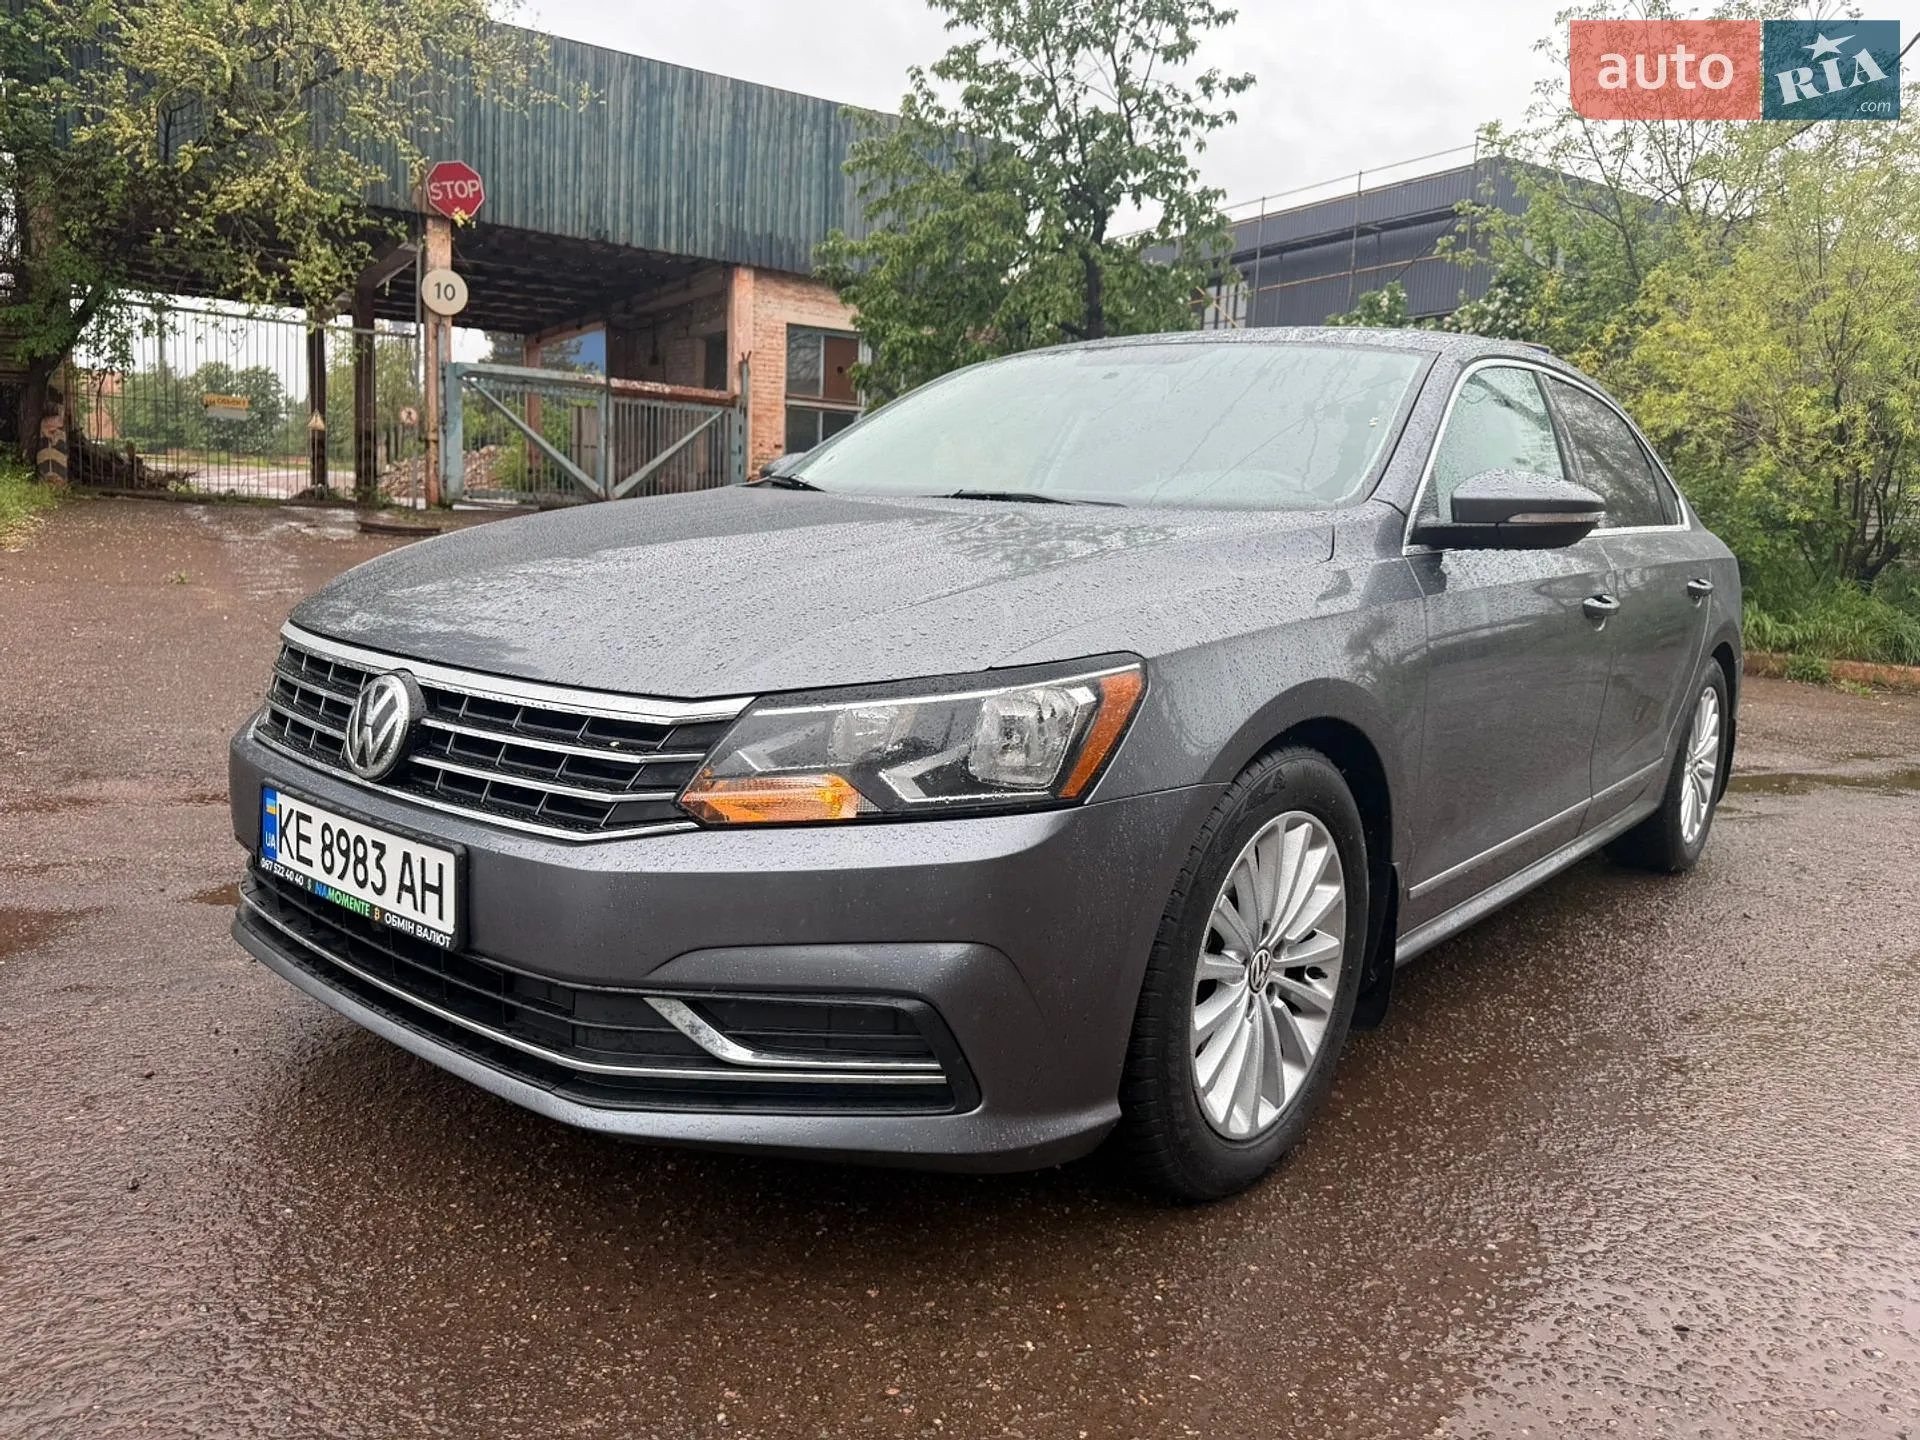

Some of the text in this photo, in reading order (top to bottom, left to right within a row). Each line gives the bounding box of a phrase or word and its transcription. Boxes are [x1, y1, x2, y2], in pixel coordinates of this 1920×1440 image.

[430, 180, 480, 200] STOP
[434, 282, 456, 301] 10
[265, 832, 276, 849] UA
[278, 803, 444, 921] KE 8983 AH
[315, 881, 370, 917] NAMOMENTE
[384, 912, 451, 948] ОБМІН ВАЛЮТ
